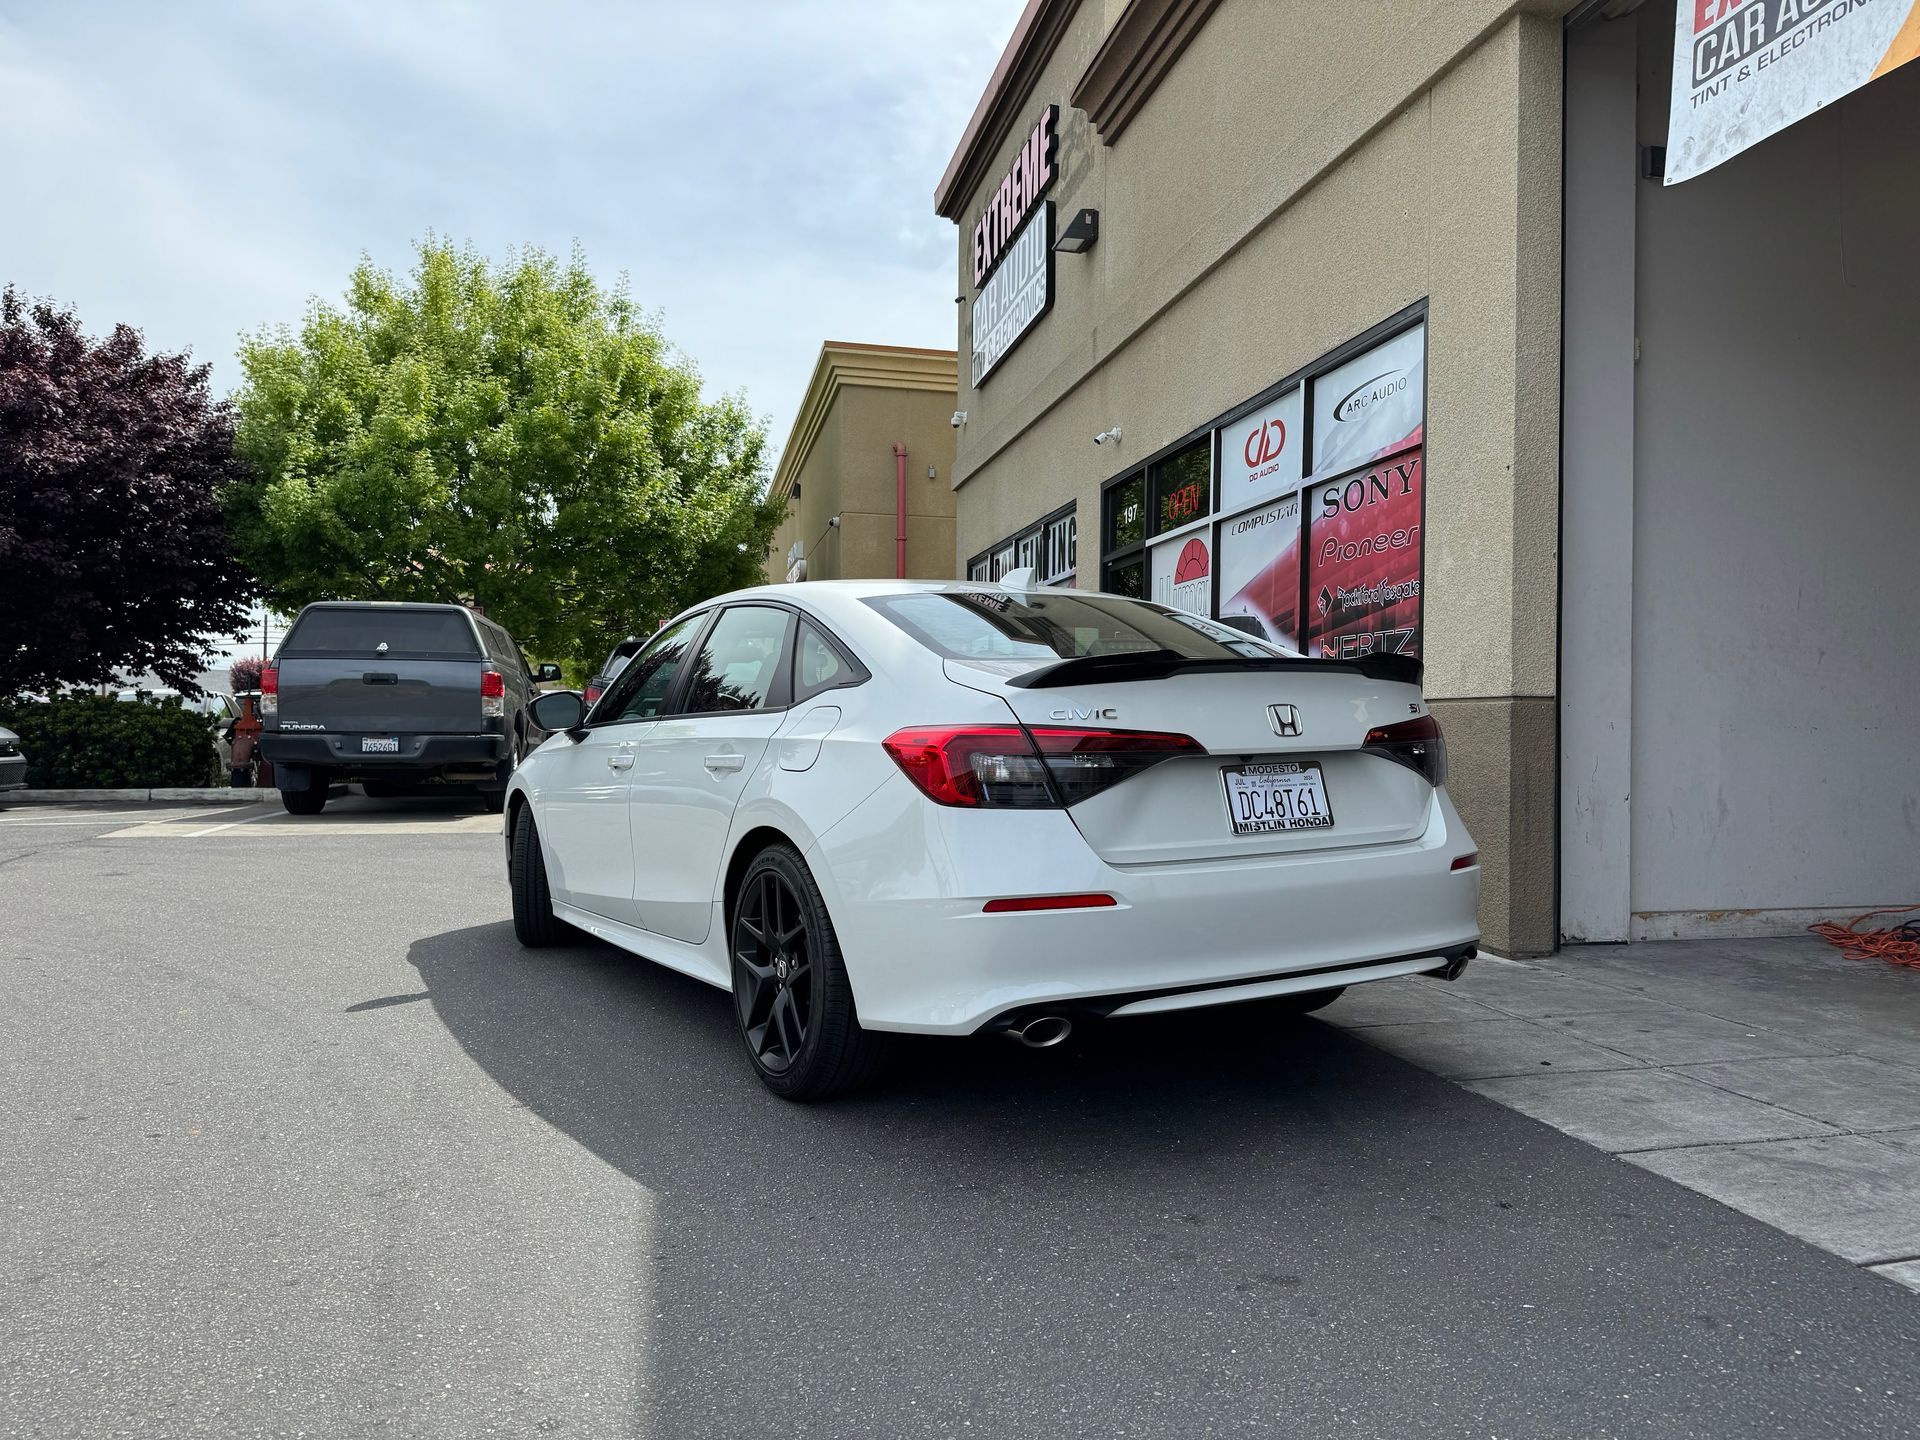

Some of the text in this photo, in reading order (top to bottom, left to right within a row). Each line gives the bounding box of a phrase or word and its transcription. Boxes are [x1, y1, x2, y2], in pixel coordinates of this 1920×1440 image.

[1696, 0, 1823, 80] CAR A
[1690, 74, 1732, 109] TINT
[1737, 65, 1751, 82] &
[974, 104, 1056, 288] EXTREME
[973, 207, 1046, 346] CAR AUDIO
[1346, 377, 1407, 415] ARC AUDIO
[1260, 463, 1279, 478] AUDIO
[1168, 482, 1200, 520] OPEN
[1322, 459, 1420, 519] SONY
[1123, 503, 1138, 524] 197
[1231, 502, 1299, 536] COMPUSTAR
[1318, 525, 1420, 568] Pioneer
[1337, 577, 1420, 613] Rockford Fosgate
[1320, 628, 1415, 660] HERTZ
[1049, 708, 1118, 720] CIVIC
[1248, 764, 1298, 775] MODESTO
[1238, 788, 1321, 820] DC48T61
[1239, 817, 1329, 833] MISTLIN HONDA
